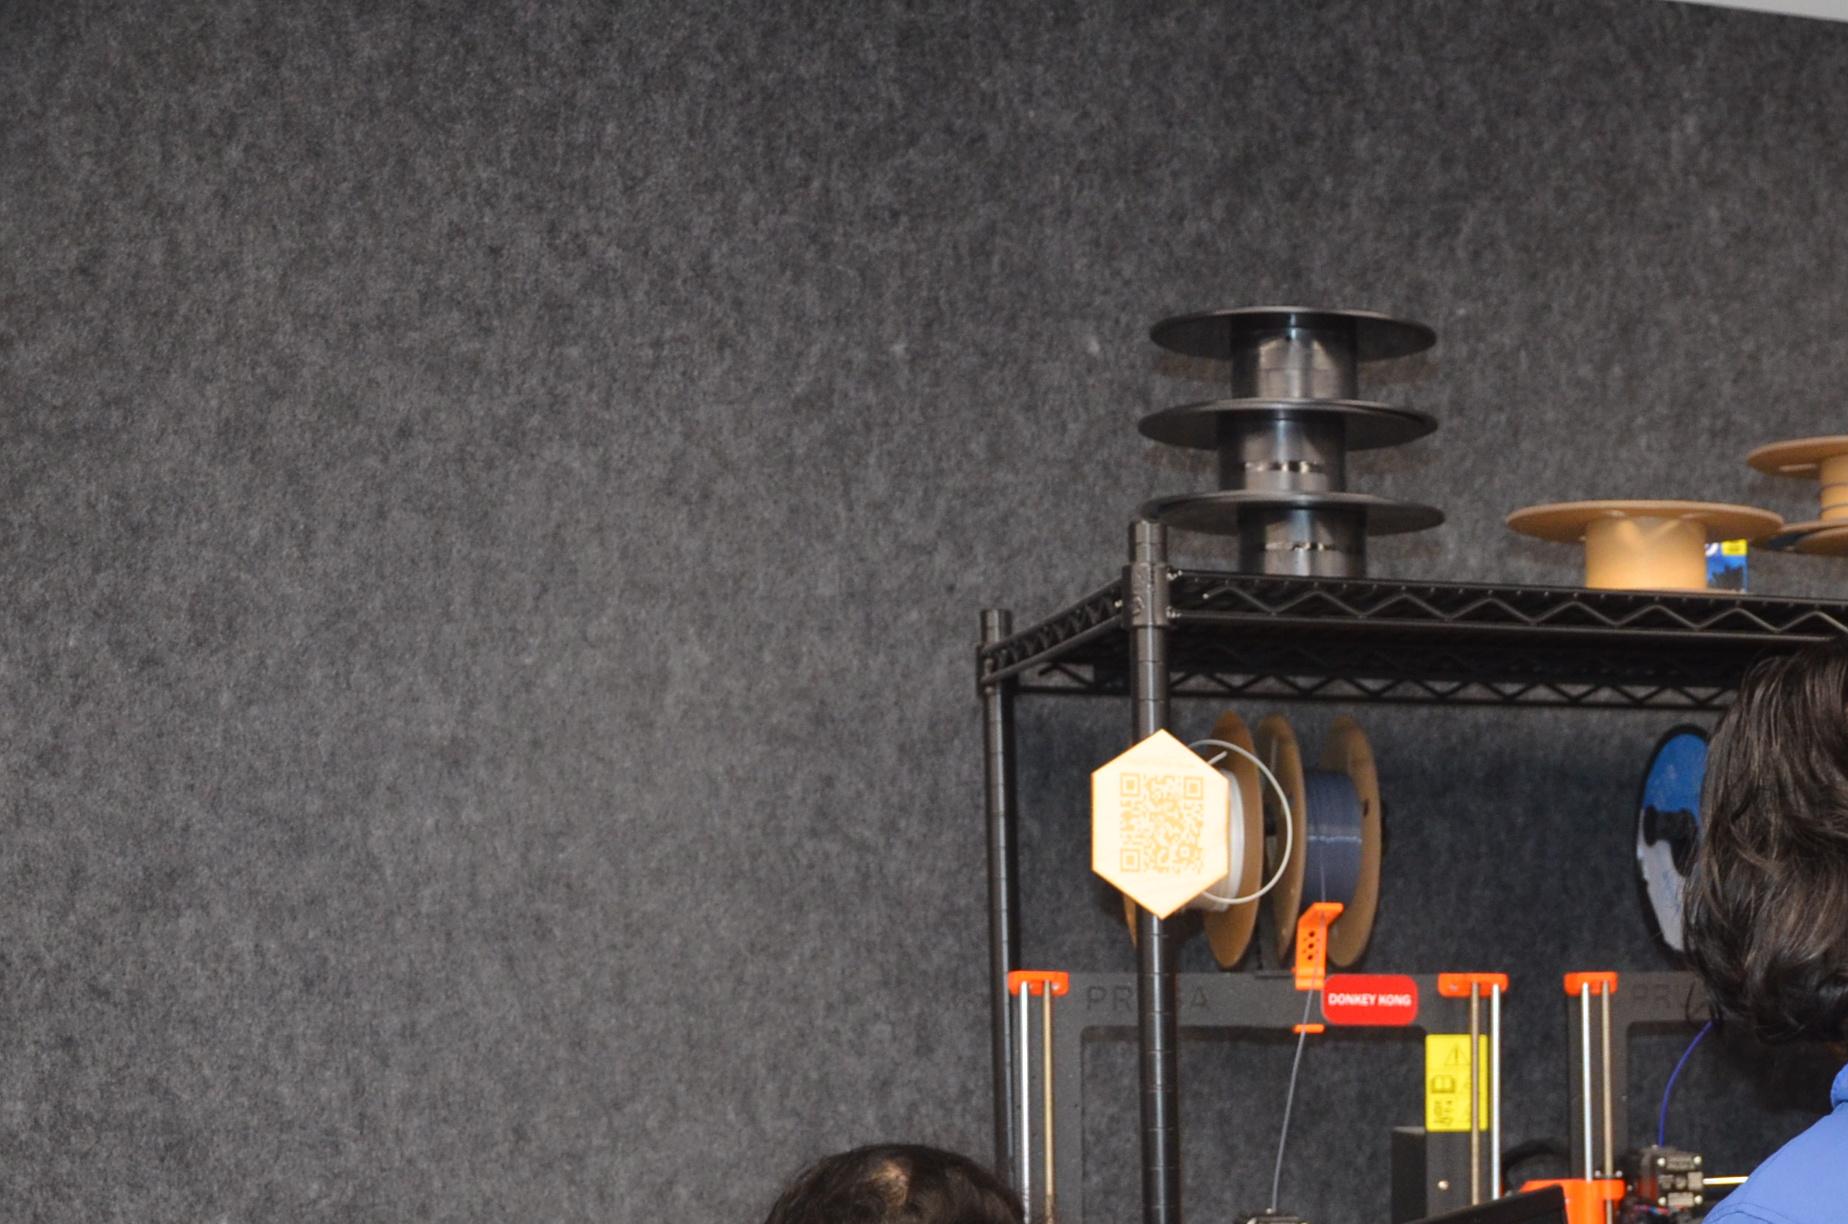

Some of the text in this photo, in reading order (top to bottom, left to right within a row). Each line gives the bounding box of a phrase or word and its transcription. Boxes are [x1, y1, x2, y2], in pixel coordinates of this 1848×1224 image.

[1086, 985, 1210, 1011] PRA
[1327, 993, 1412, 1007] DONKEY KONG
